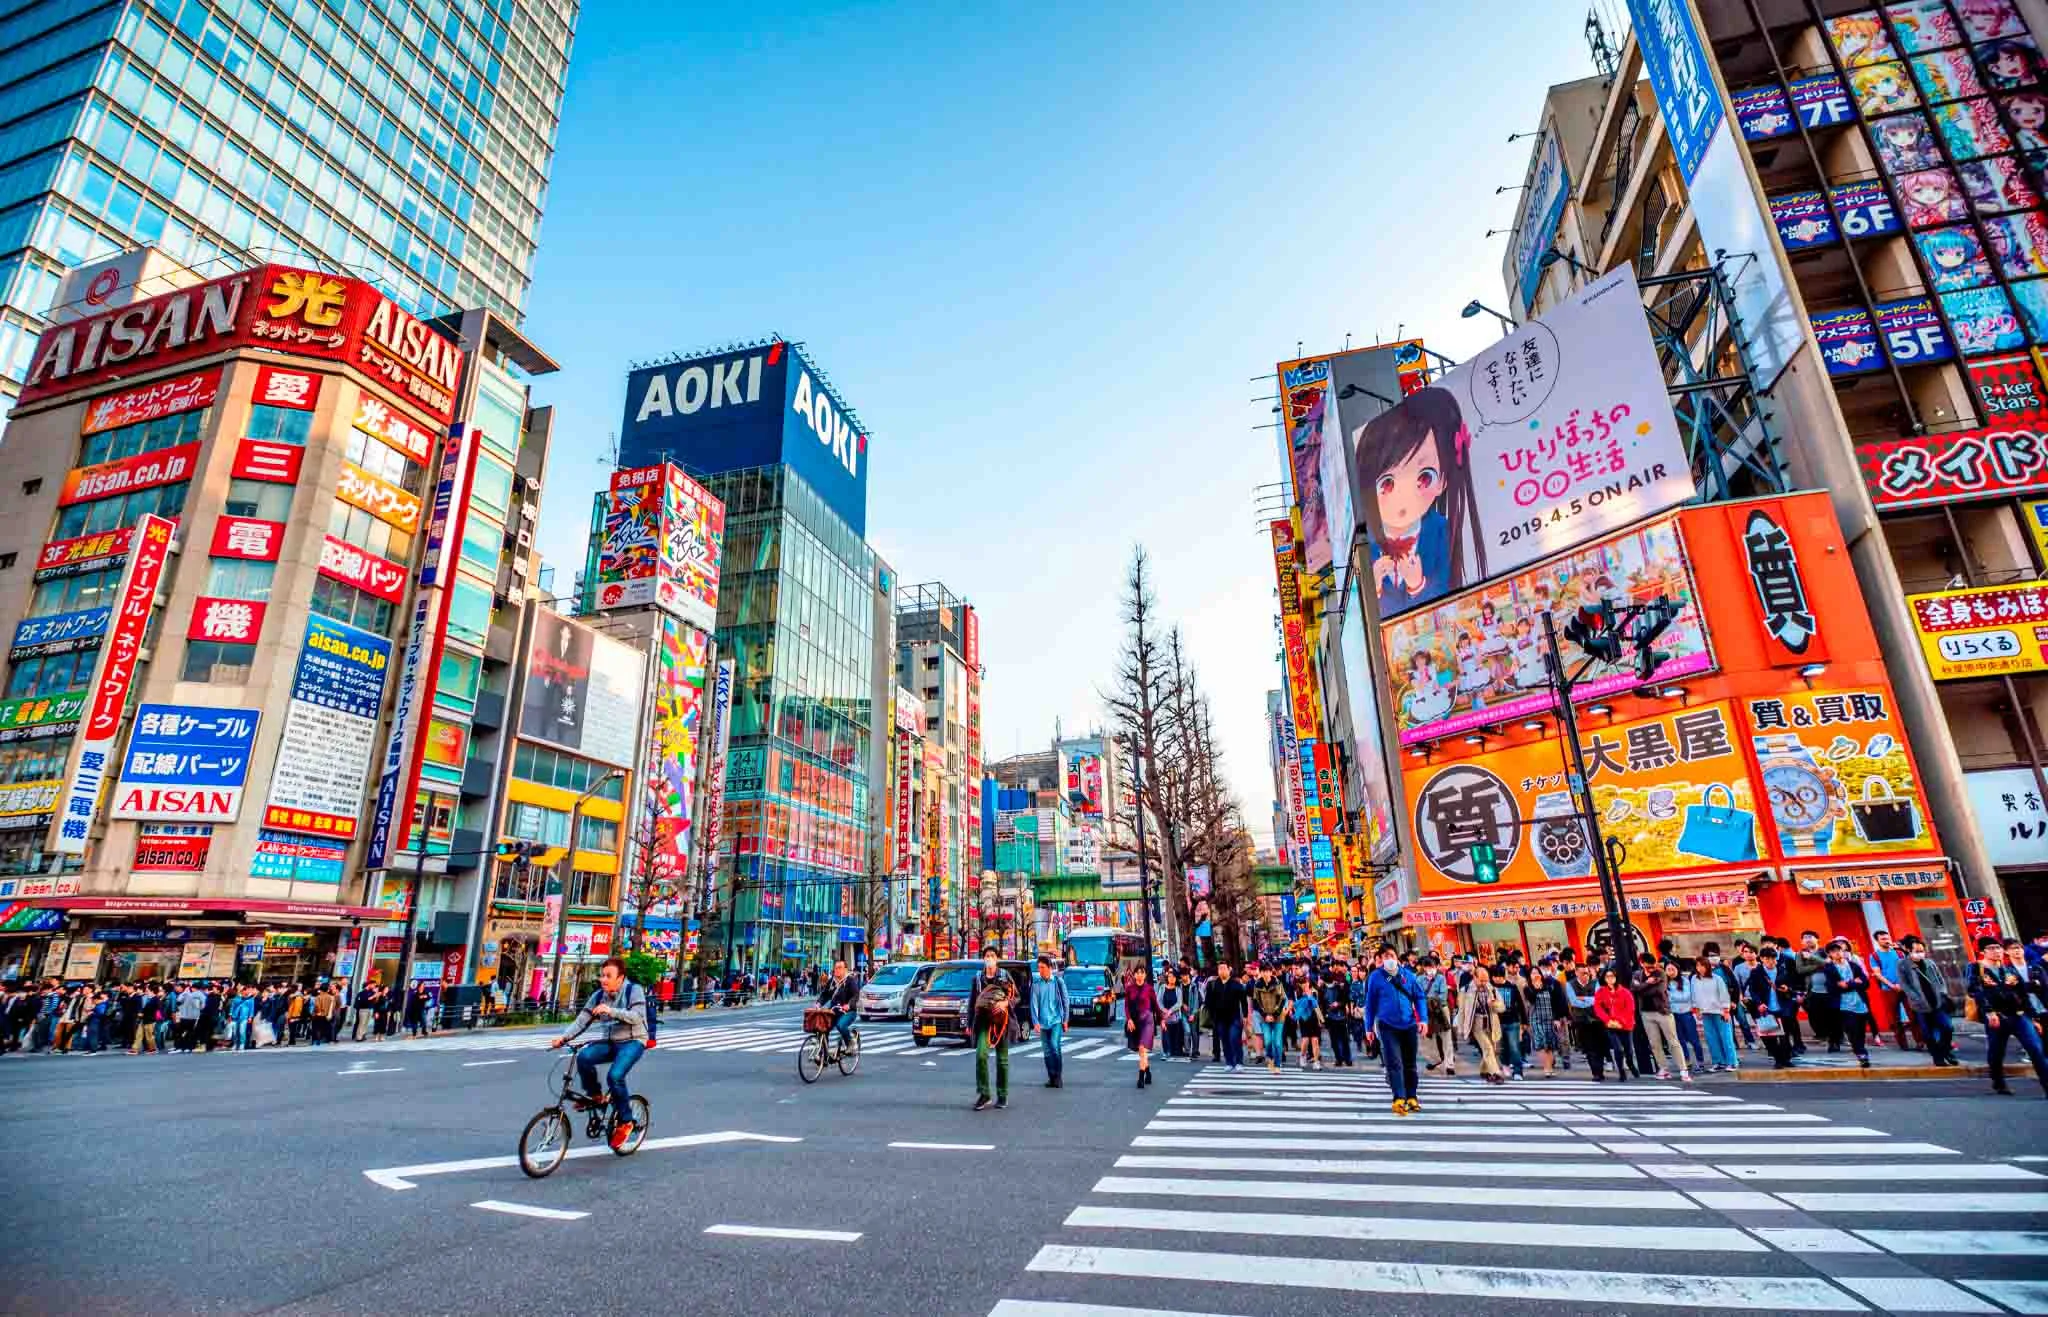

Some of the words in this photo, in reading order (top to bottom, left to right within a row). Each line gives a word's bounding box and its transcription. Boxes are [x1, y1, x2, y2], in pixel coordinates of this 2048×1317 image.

[1800, 98, 1849, 127] 7F
[1843, 204, 1896, 235] 6F
[268, 272, 347, 328] 光
[30, 276, 249, 386] AISAN
[251, 320, 346, 349] ネットワーク
[365, 299, 463, 389] AISAN
[1888, 326, 1945, 359] 5F
[1522, 336, 1544, 382] 友達に
[265, 371, 311, 405] 愛
[635, 356, 762, 423] AOKI
[1504, 351, 1527, 406] なりたい
[1986, 394, 2041, 412] Stars
[355, 399, 430, 458] 光通信
[793, 371, 857, 479] AOKI
[1498, 403, 1631, 474] ひとりぼっちの
[75, 455, 187, 499] aisan.co.jp
[245, 445, 292, 477] 三
[617, 469, 659, 488] 免税店
[337, 468, 418, 524] ネットワーク
[1588, 482, 1622, 506] ON
[1628, 463, 1668, 492] AIR
[43, 545, 65, 564] 3F
[227, 521, 272, 557] 電
[318, 540, 404, 592] 配線パーツ
[41, 610, 110, 638] ネットワーク
[94, 524, 168, 730] 光・ケーブル・ネットワーク
[203, 602, 252, 639] 機
[1925, 593, 2048, 627] 全身もみほ
[18, 623, 40, 642] 2F
[1945, 636, 2014, 657] りらくる
[308, 631, 387, 671] aisan.co.jp
[717, 665, 730, 709] AKKY
[140, 712, 250, 740] 各種ケーブル
[1580, 707, 1734, 781] 大黒屋
[129, 752, 241, 778] 配線パーツ
[62, 751, 105, 840] 愛三電機
[119, 789, 234, 814] AISAN
[1289, 762, 1304, 812] Tax-free
[2001, 790, 2041, 812] 喫茶
[370, 776, 394, 860] AISAN
[1296, 814, 1307, 845] Shop
[137, 849, 207, 867] aisan.co.jp
[1685, 889, 1746, 907] 無料査定
[1828, 871, 1945, 891] 1階にて高価買取中
[1966, 900, 1986, 915] 4F
